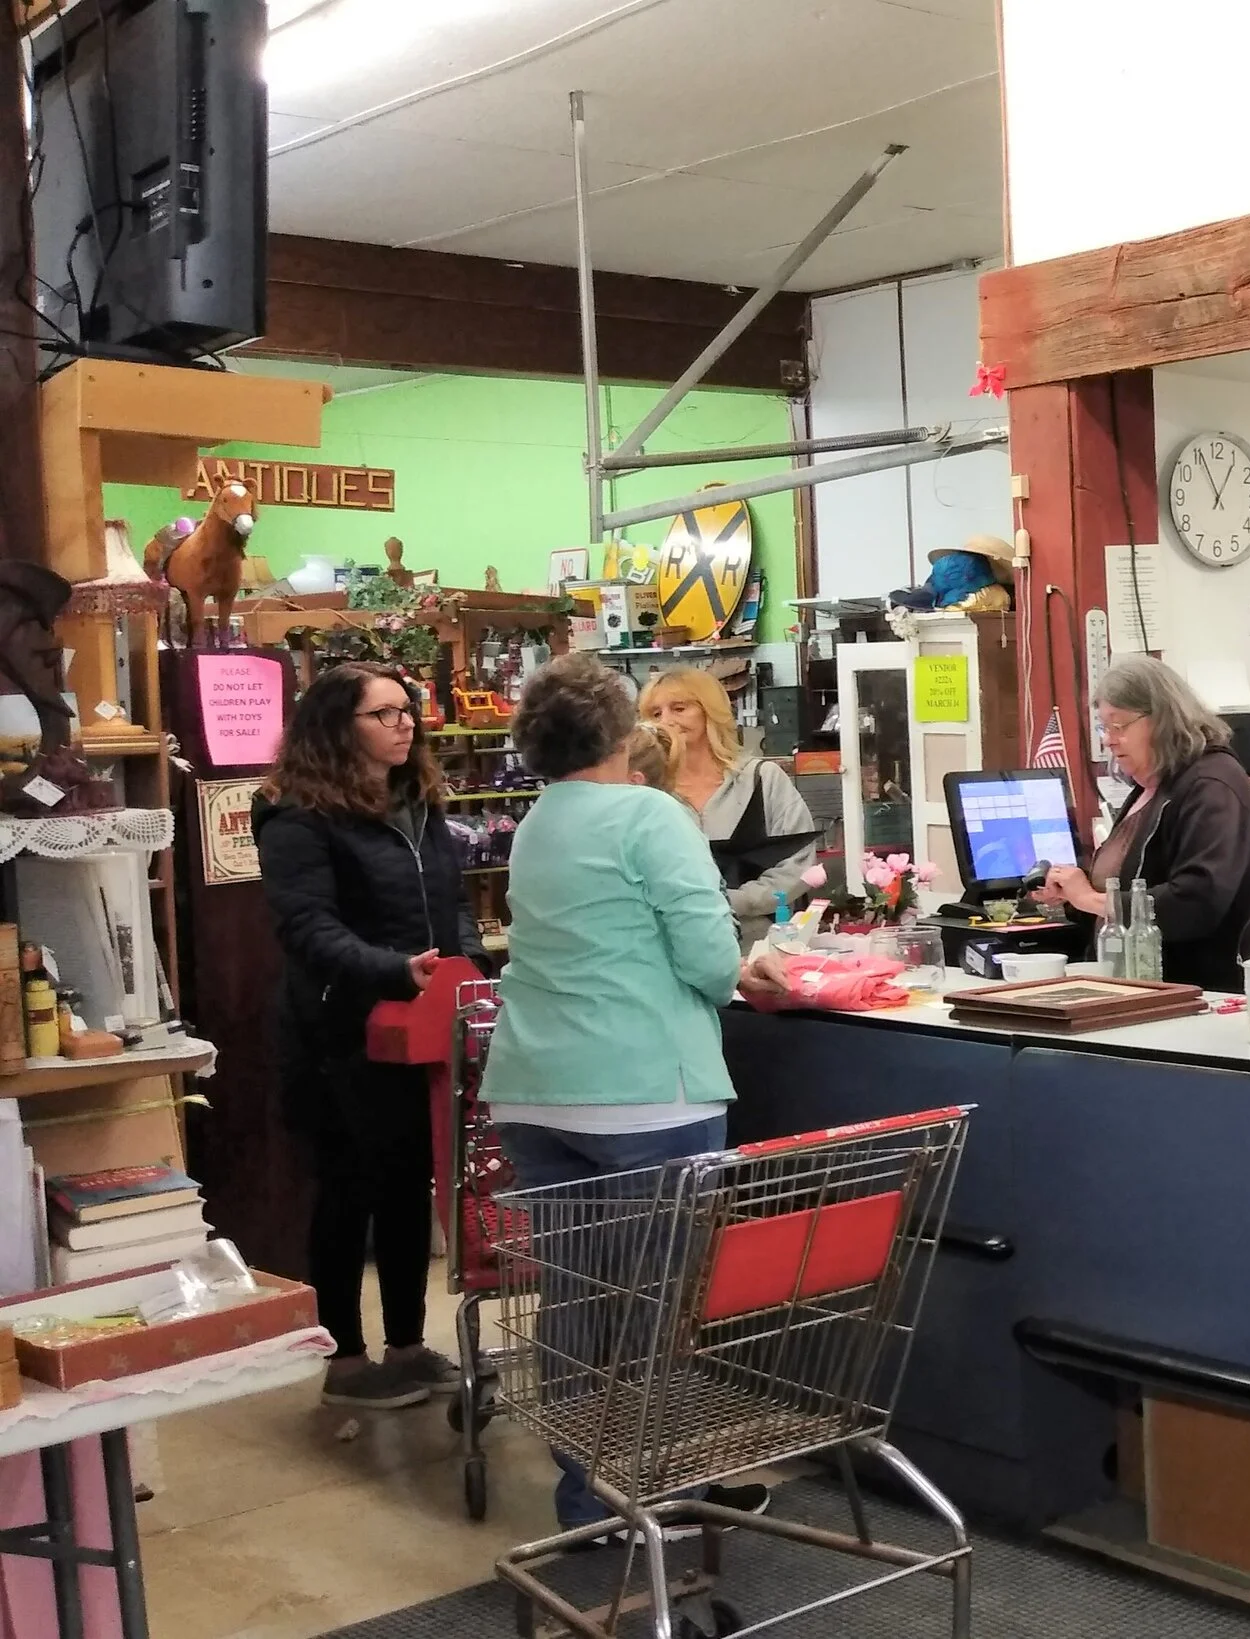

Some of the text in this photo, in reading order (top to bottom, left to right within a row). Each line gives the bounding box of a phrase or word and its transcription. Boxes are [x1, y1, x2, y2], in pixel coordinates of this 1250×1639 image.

[1210, 442, 1224, 460] 12
[1179, 464, 1192, 482] 10
[1175, 489, 1185, 506] 9
[1181, 514, 1191, 532] 8
[1195, 534, 1204, 551] 7
[1213, 540, 1222, 557] 6
[1230, 535, 1239, 552] 5
[221, 667, 251, 676] PLEASE
[929, 663, 957, 672] VENDOR
[213, 683, 264, 691] DO NOT LET
[209, 698, 272, 707] CHILDREN PLAY
[217, 713, 263, 721] WITH TOYS
[219, 728, 261, 737] FOR SALE!
